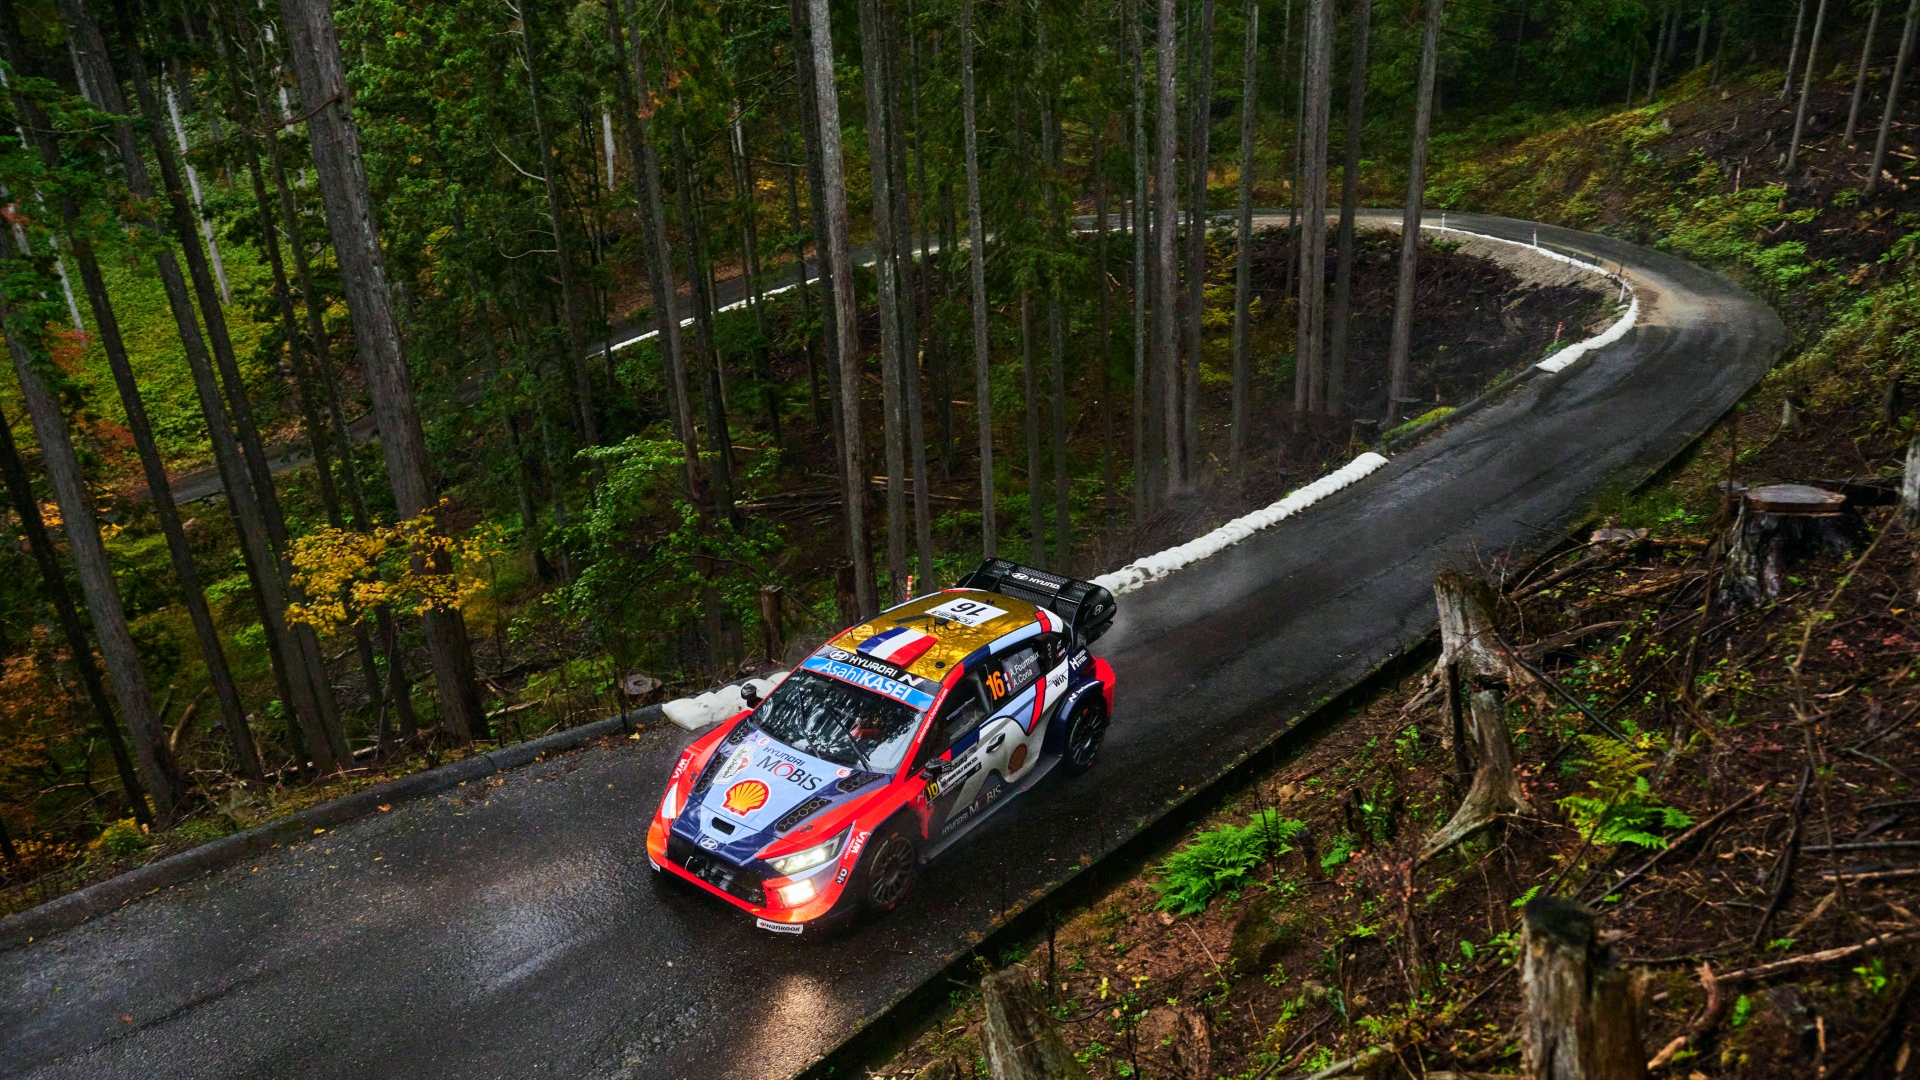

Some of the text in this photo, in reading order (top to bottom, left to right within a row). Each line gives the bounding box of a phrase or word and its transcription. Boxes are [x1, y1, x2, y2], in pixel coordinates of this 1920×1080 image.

[1029, 577, 1060, 590] HYUND
[950, 602, 988, 617] 16
[848, 655, 898, 678] HYUNDAI
[1009, 651, 1040, 677] A.Fourmaux
[819, 661, 913, 701] AsahiKASEI
[985, 670, 1006, 700] 16
[763, 746, 806, 767] HYUNDAI
[756, 754, 823, 792] MOBIS
[850, 830, 869, 860] WIA
